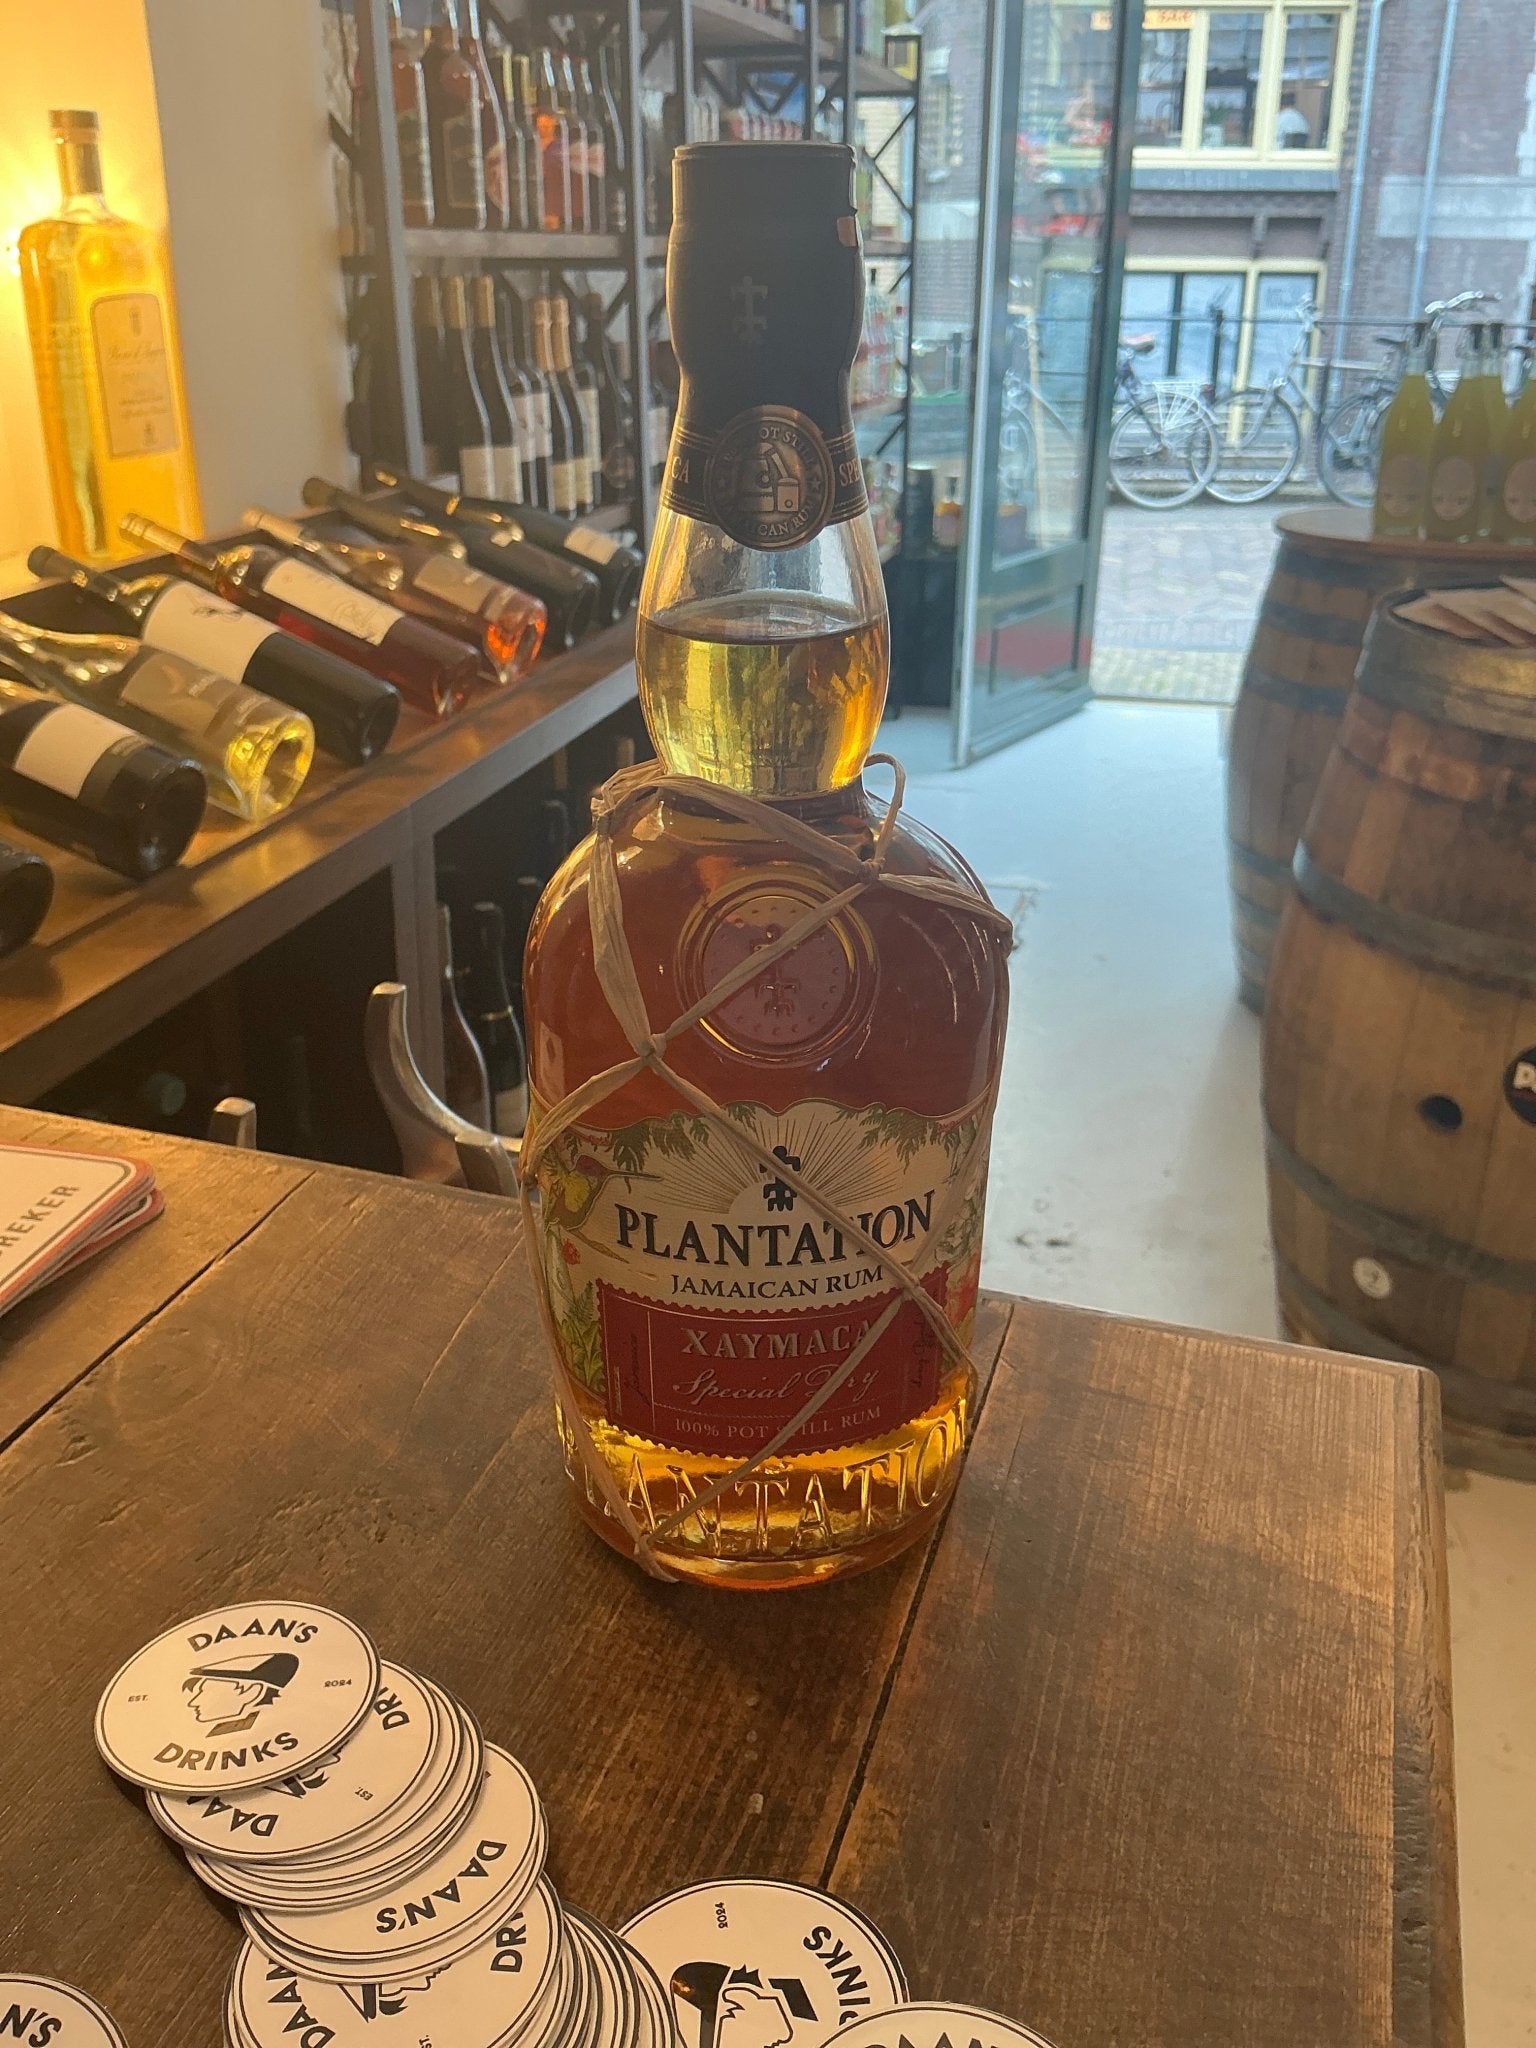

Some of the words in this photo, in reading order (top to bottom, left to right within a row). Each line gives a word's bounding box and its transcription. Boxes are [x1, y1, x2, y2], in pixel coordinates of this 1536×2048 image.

[0, 1186, 80, 1250] HEKER
[671, 1274, 819, 1299] JAMAICAN
[825, 1264, 884, 1294] RUM
[672, 1367, 802, 1406] Special
[675, 1418, 720, 1438] 100%
[727, 1425, 769, 1439] POT
[841, 1405, 881, 1429] RUM
[187, 1618, 319, 1653] DAAN'S
[128, 1694, 149, 1703] EST.
[324, 1678, 352, 1688] 2024
[153, 1731, 300, 1772] DRINKS
[375, 1839, 508, 1934] DAAN'S
[714, 1901, 729, 1930] 2024
